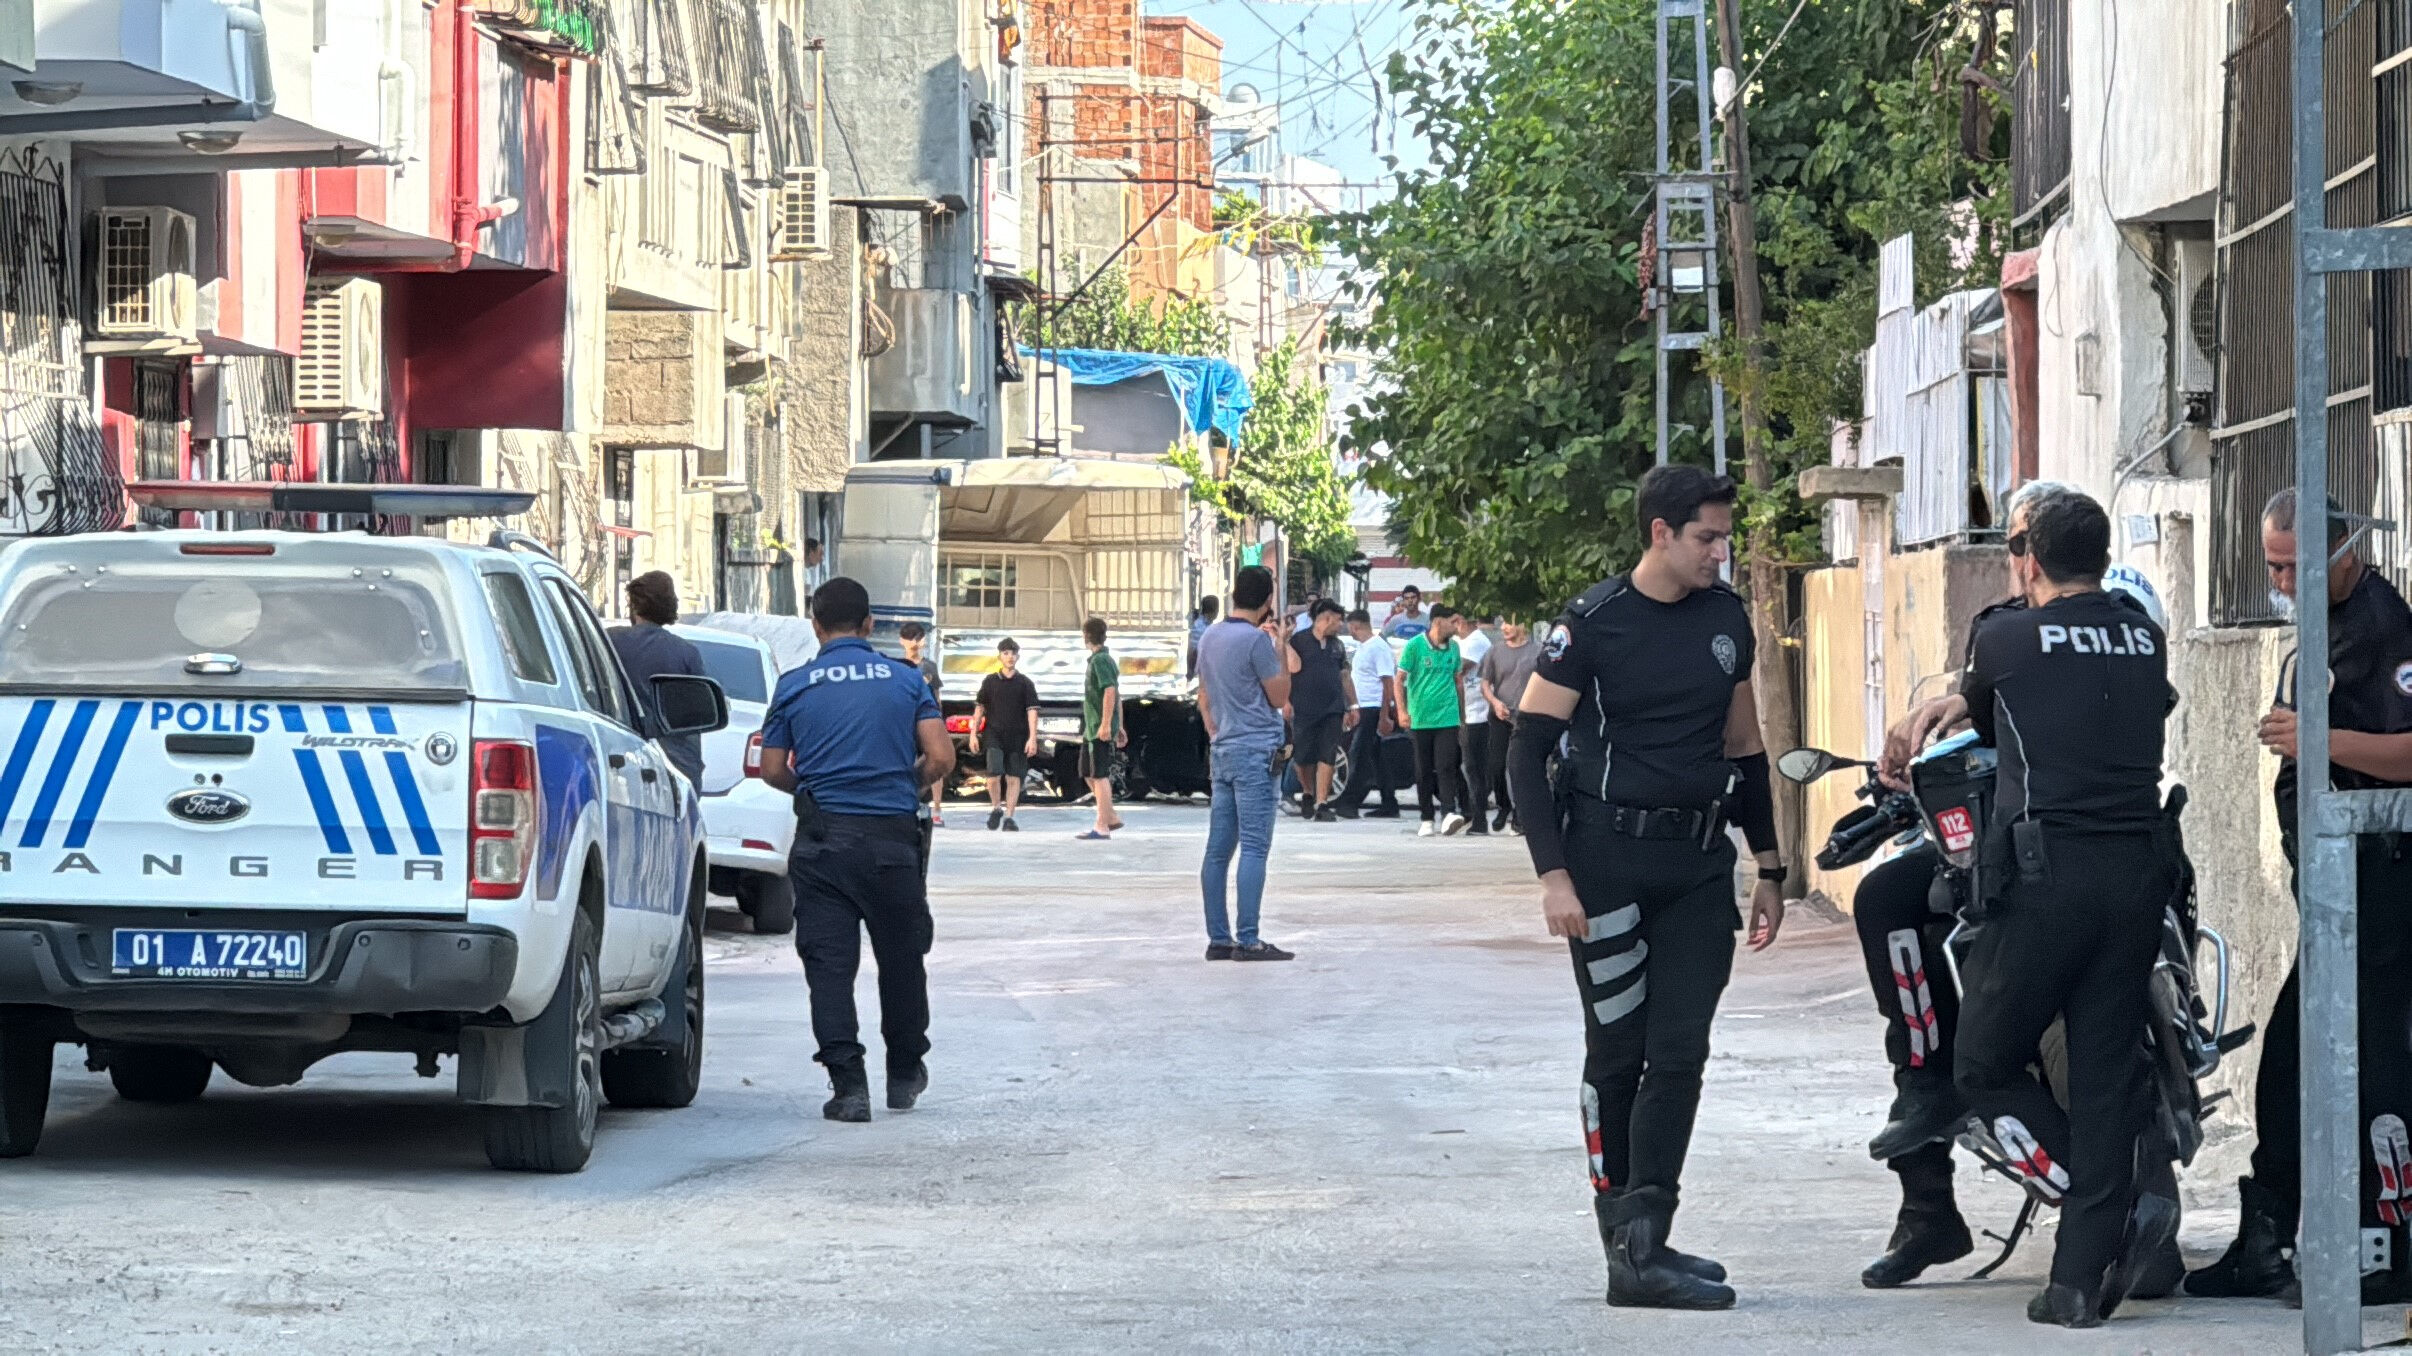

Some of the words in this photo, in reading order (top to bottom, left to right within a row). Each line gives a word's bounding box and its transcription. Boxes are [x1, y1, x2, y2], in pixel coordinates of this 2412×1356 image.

[184, 795, 230, 815] Ford
[1941, 812, 1969, 835] 112
[0, 851, 444, 881] ANGER
[132, 934, 164, 966] 01
[190, 934, 207, 966] A
[216, 934, 301, 967] 72240
